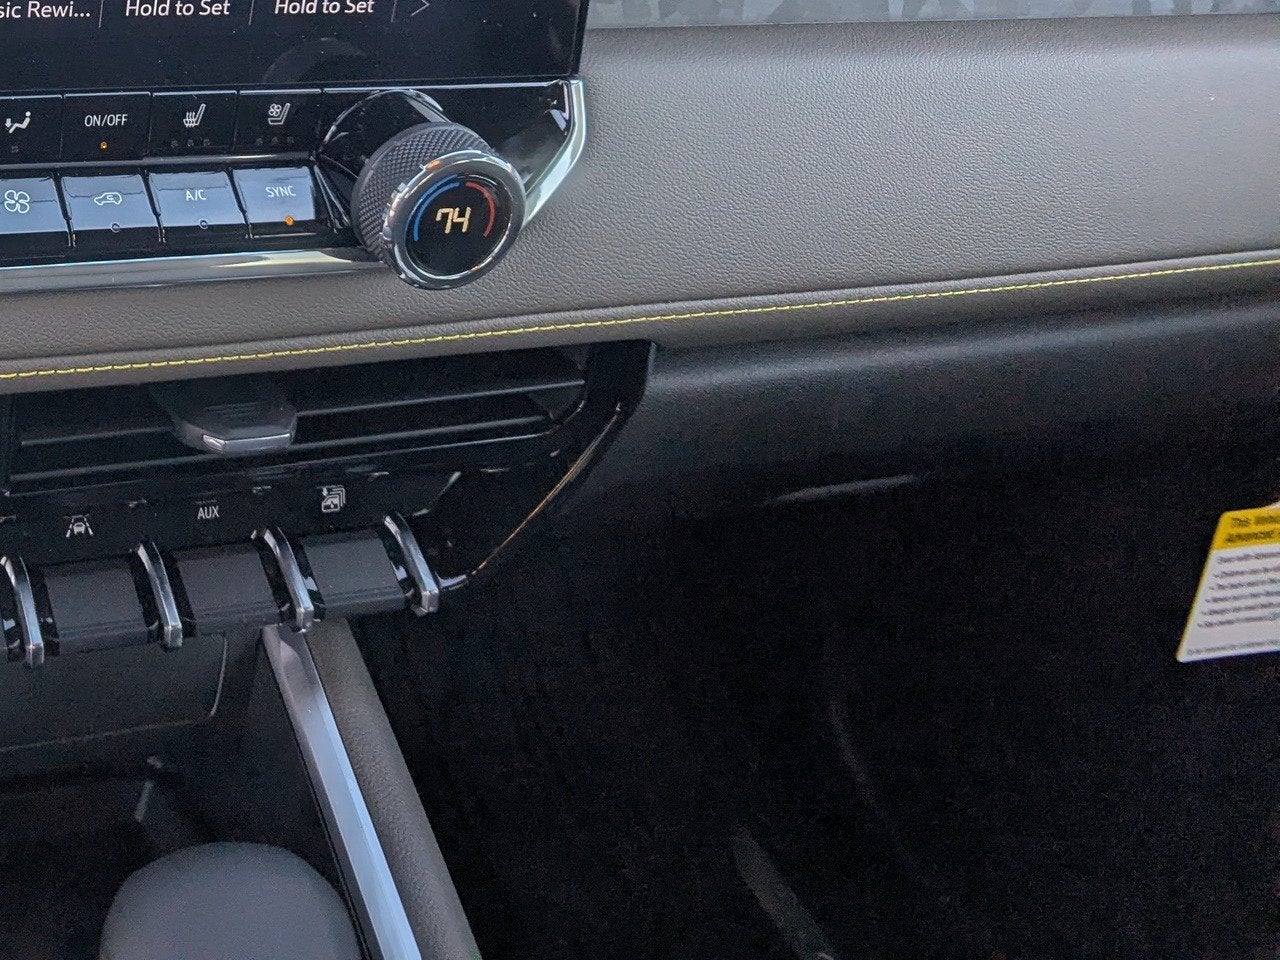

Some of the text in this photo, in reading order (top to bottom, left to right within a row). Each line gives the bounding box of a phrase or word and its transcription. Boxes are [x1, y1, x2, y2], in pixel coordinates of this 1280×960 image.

[124, 0, 170, 17] Hold
[175, 2, 195, 17] to
[83, 112, 128, 128] ON/OFF
[185, 188, 207, 202] A/C
[265, 184, 297, 198] SYNC
[435, 206, 472, 234] 74
[197, 505, 220, 520] AUX
